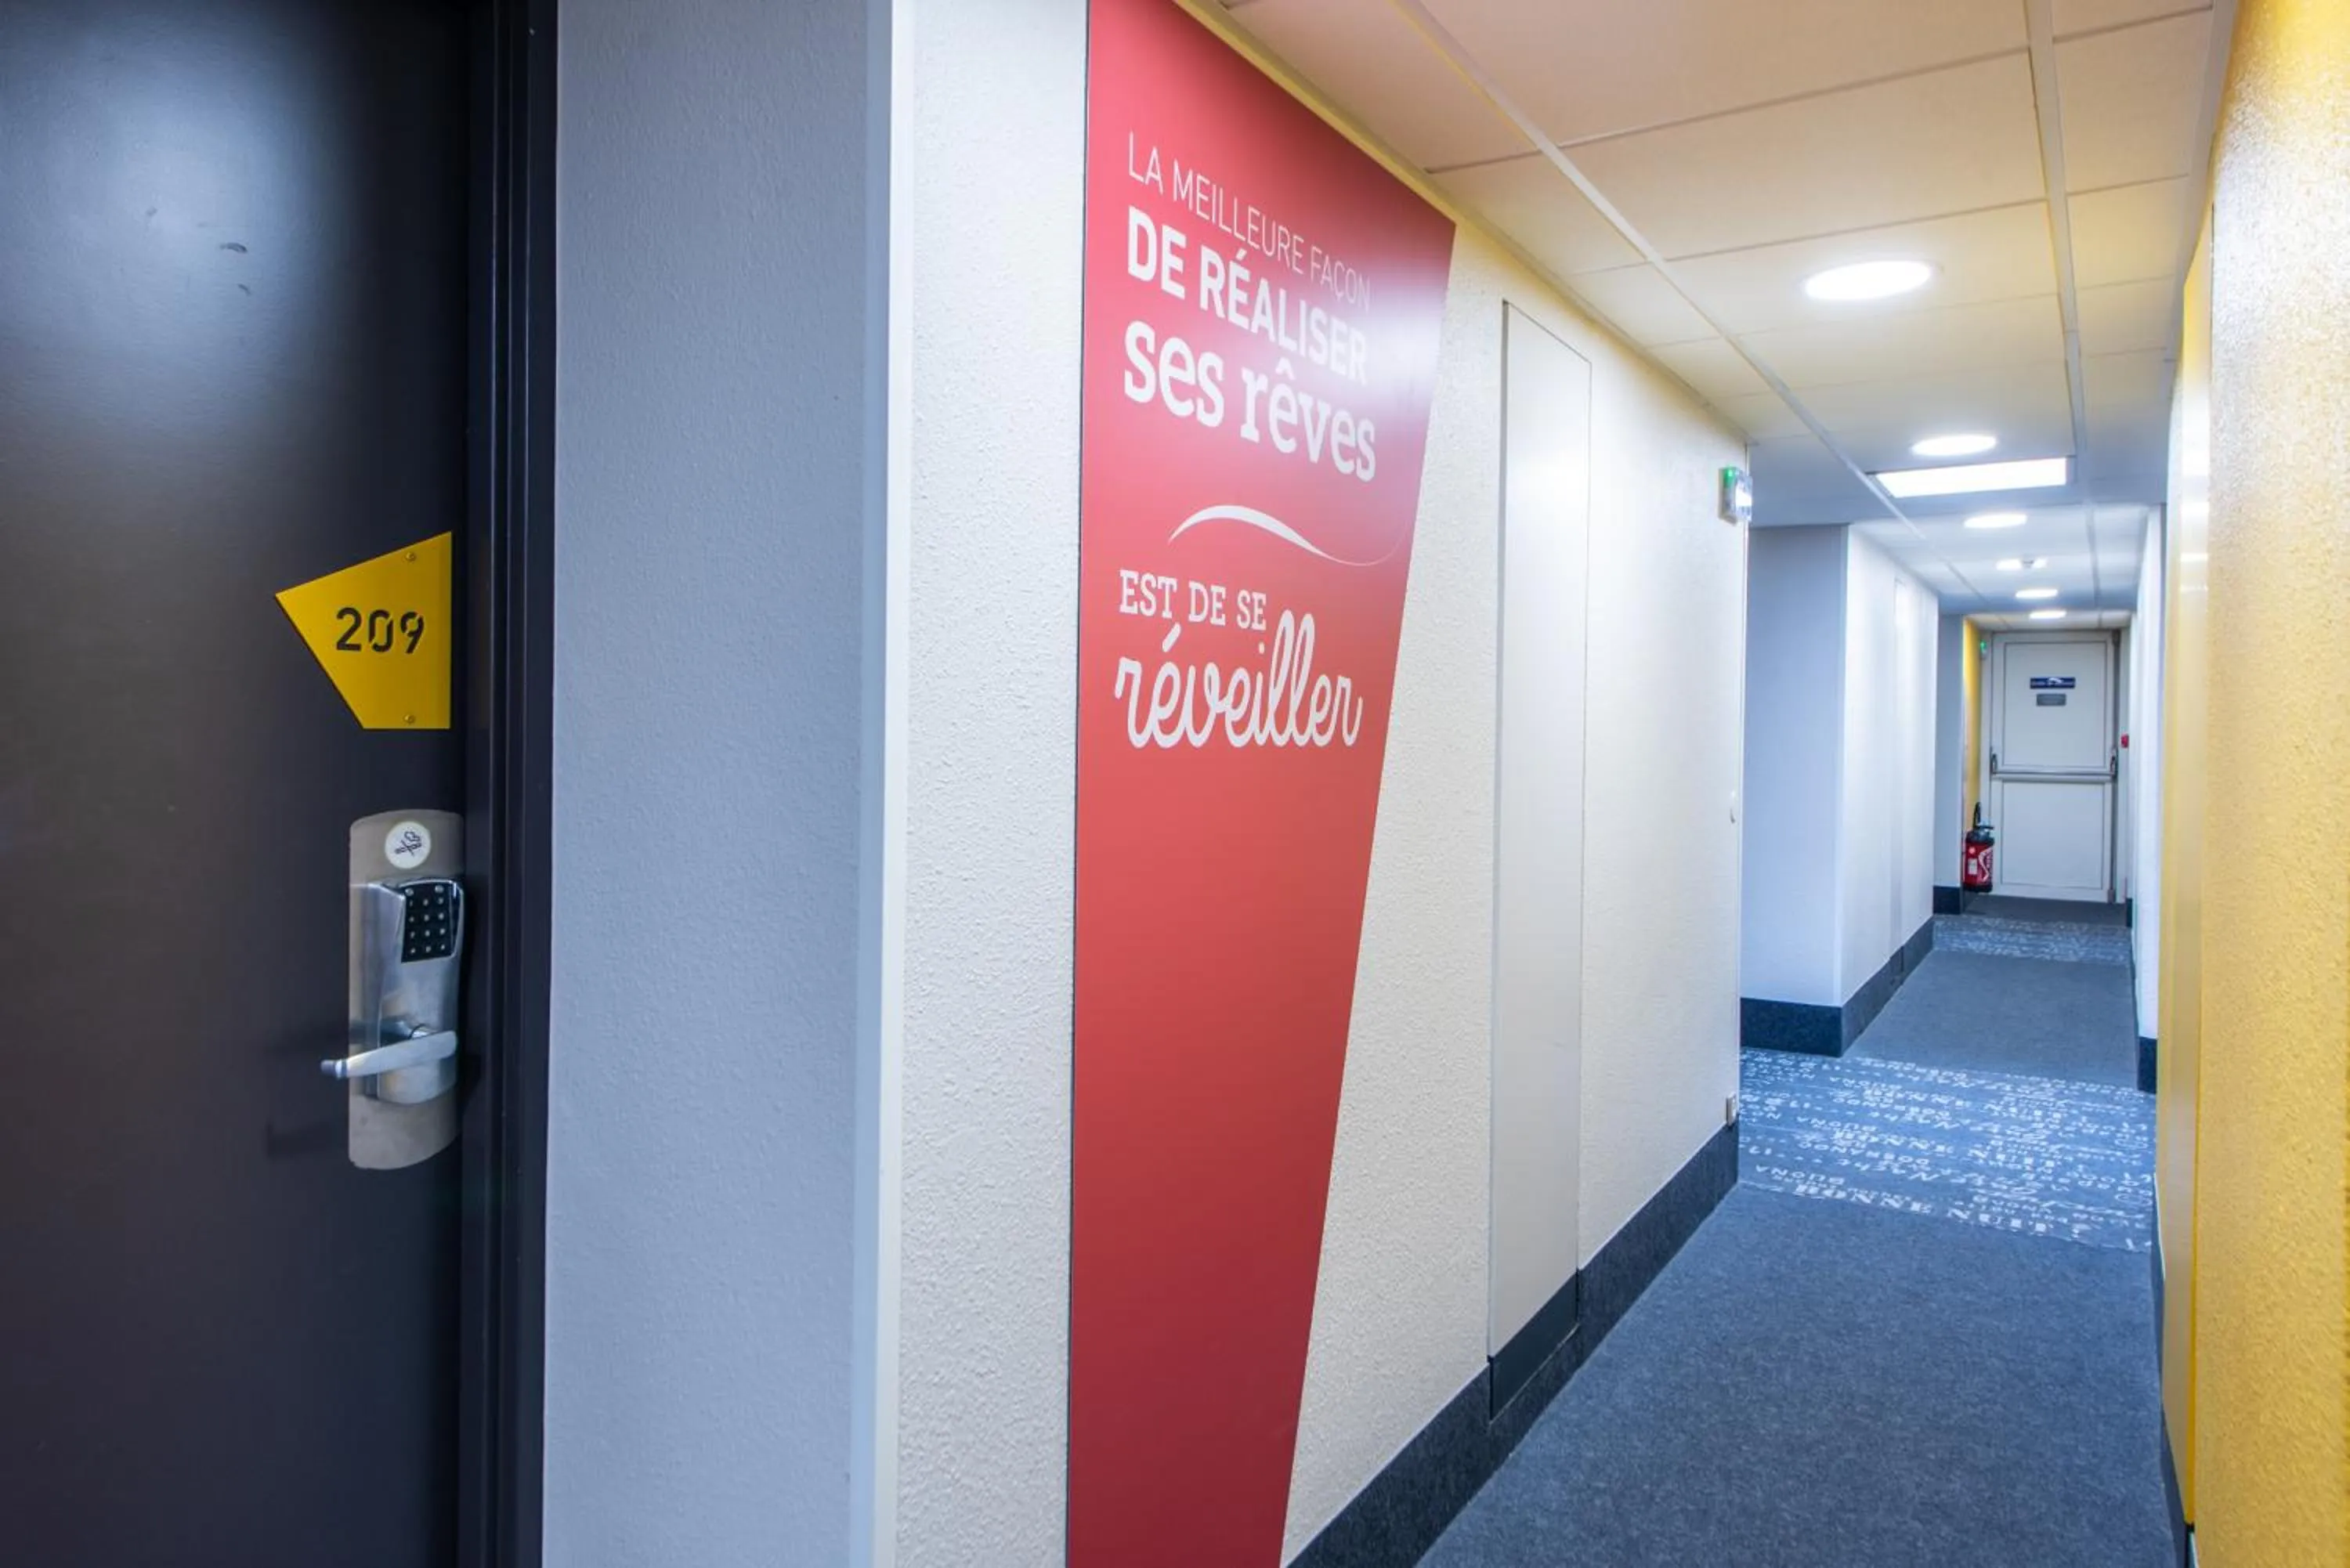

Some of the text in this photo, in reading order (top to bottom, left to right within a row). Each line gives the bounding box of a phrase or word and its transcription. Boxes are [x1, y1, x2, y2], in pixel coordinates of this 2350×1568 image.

[1129, 130, 1372, 313] LA MEILLEURE FAÇON
[1127, 205, 1368, 386] DE RÉALISER
[1124, 320, 1376, 483] ses rêves
[335, 607, 425, 655] 209
[1119, 569, 1267, 631] EST DE SE
[1114, 609, 1364, 749] réveiller
[1755, 1165, 1845, 1185] BUONA
